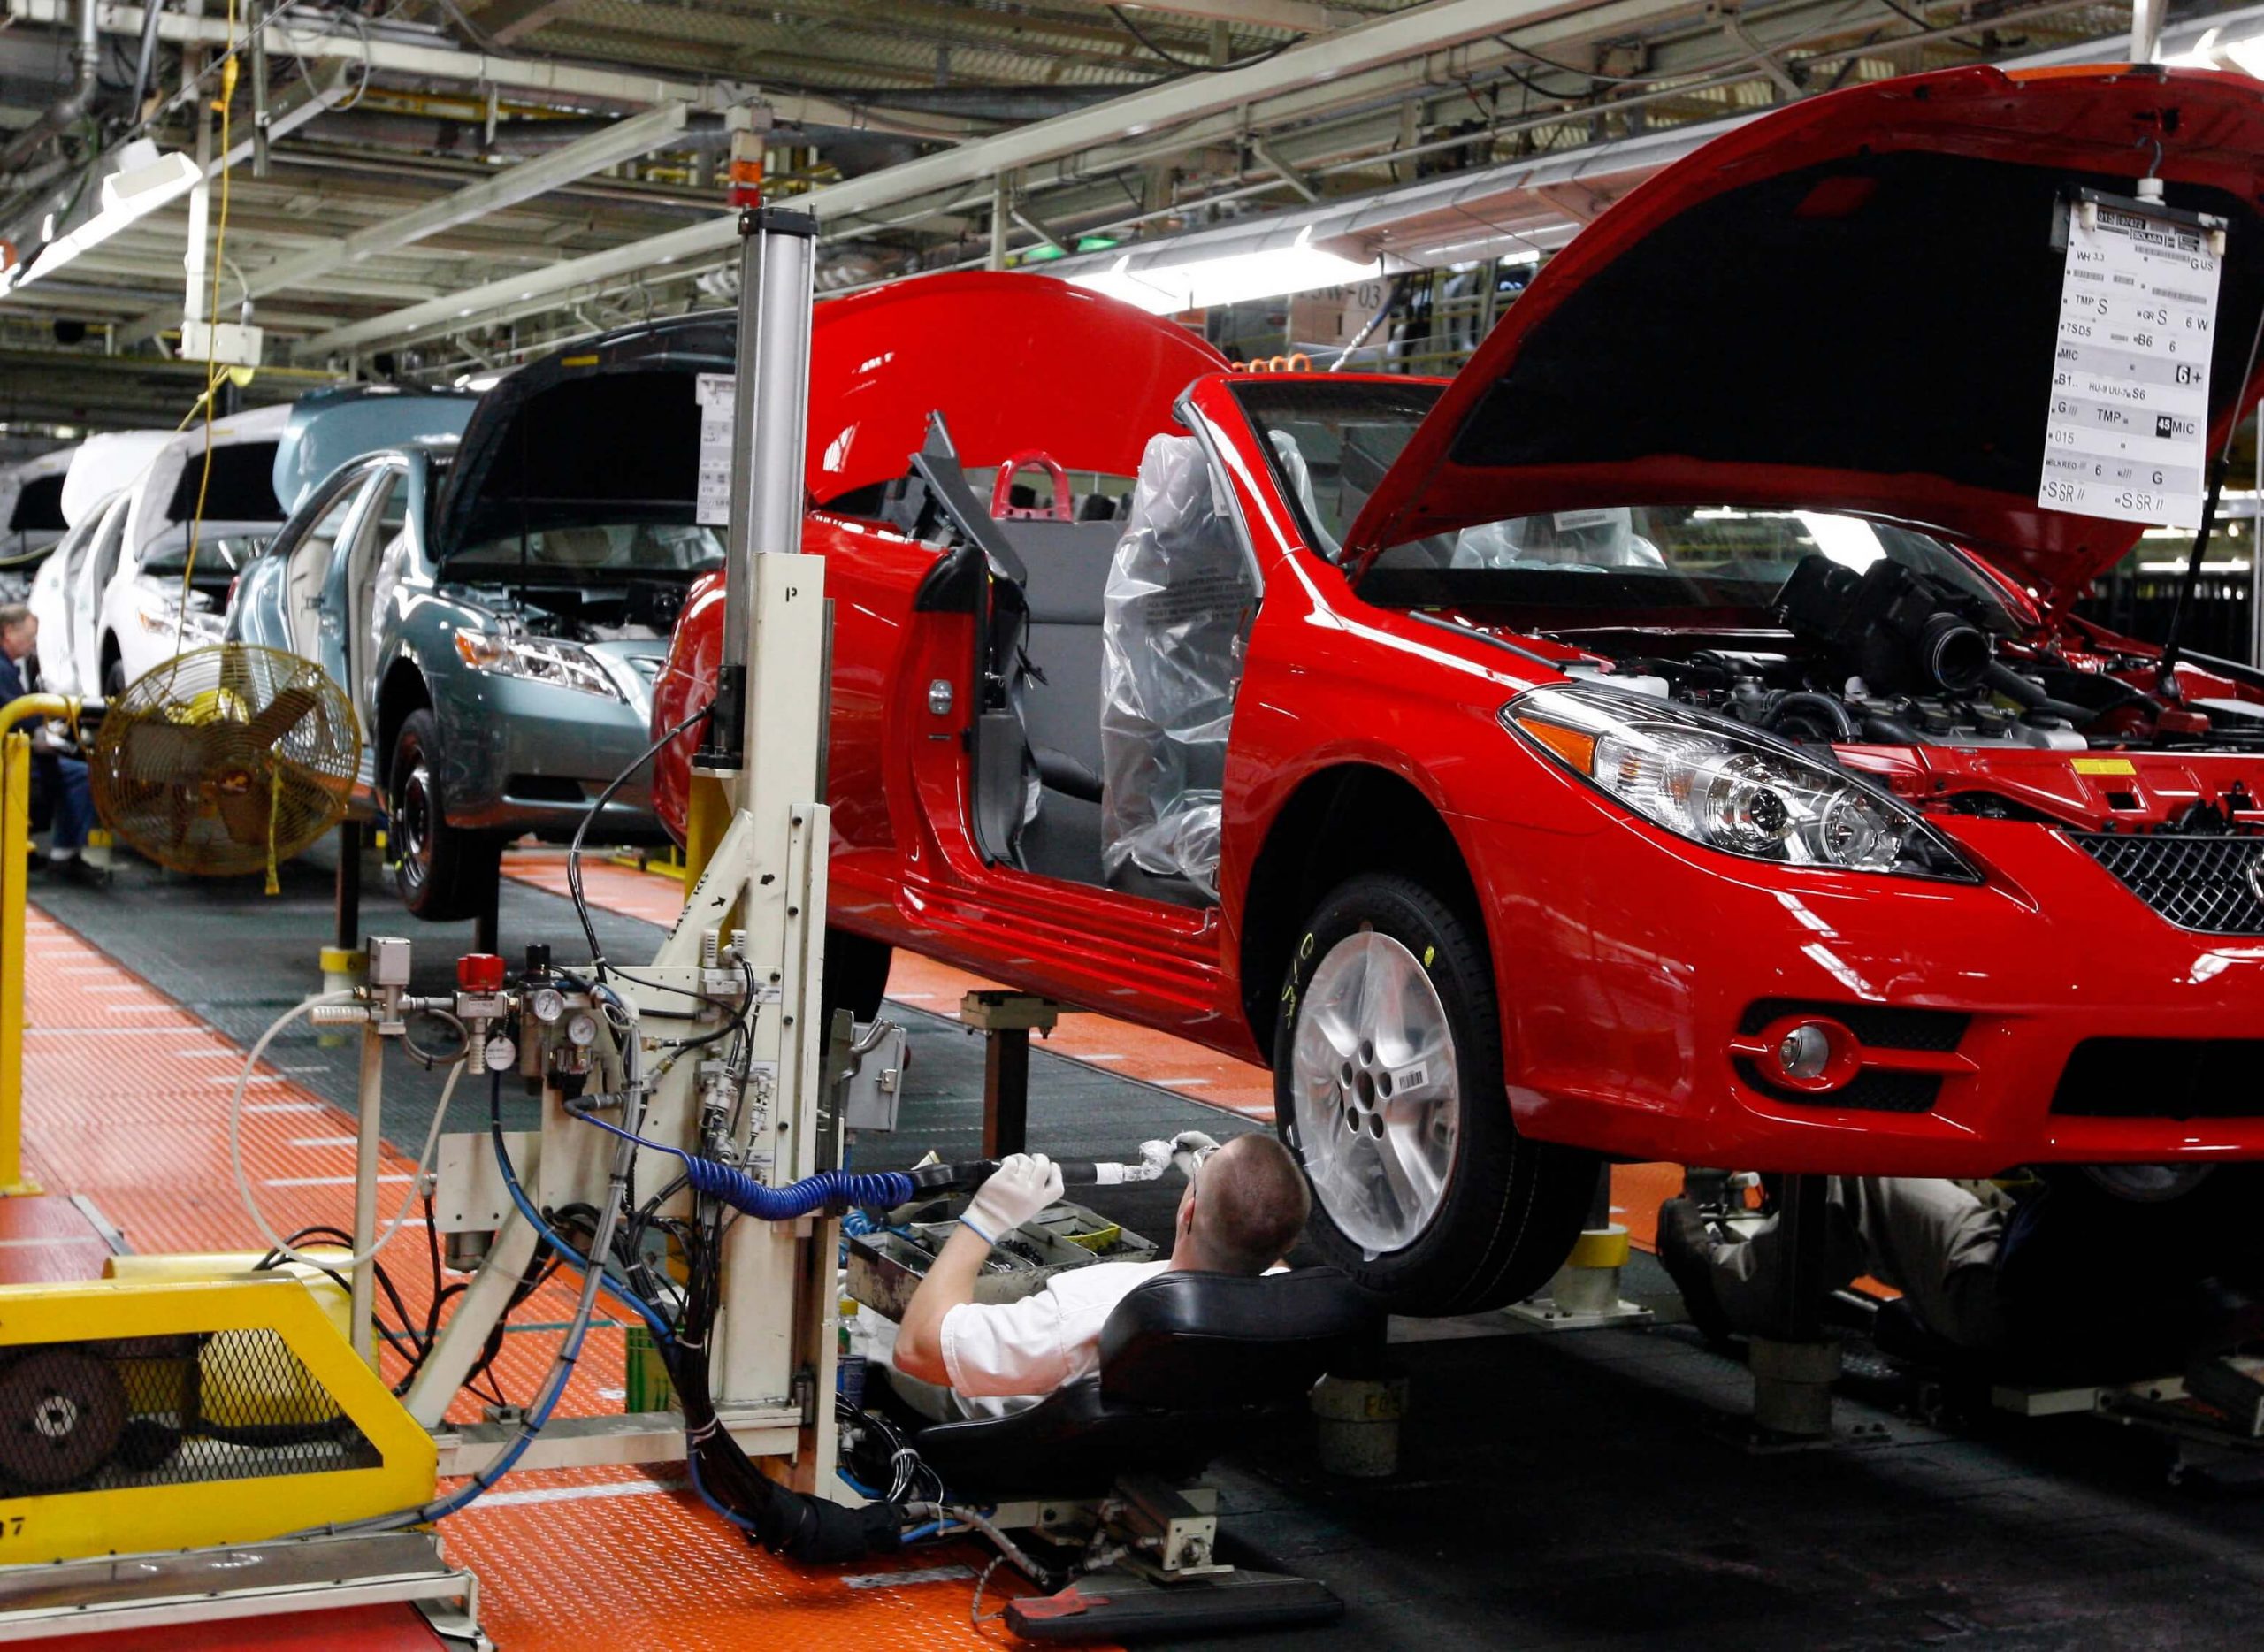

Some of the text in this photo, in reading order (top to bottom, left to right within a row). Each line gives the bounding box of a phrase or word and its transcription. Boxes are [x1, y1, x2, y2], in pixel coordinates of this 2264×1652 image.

[2076, 294, 2108, 315] TMP S
[2157, 309, 2168, 325] S
[2185, 317, 2192, 328] 6
[2197, 318, 2208, 331] W
[2168, 340, 2176, 352] 6
[2061, 348, 2078, 361] MIC
[2177, 366, 2188, 383] 6
[2132, 388, 2145, 400] S6
[2058, 401, 2066, 413] G
[2096, 409, 2122, 424] TMP
[2172, 421, 2195, 434] MIC
[2054, 430, 2075, 445] 015
[2094, 464, 2102, 476] 6
[2152, 470, 2163, 485] G
[785, 586, 798, 602] P
